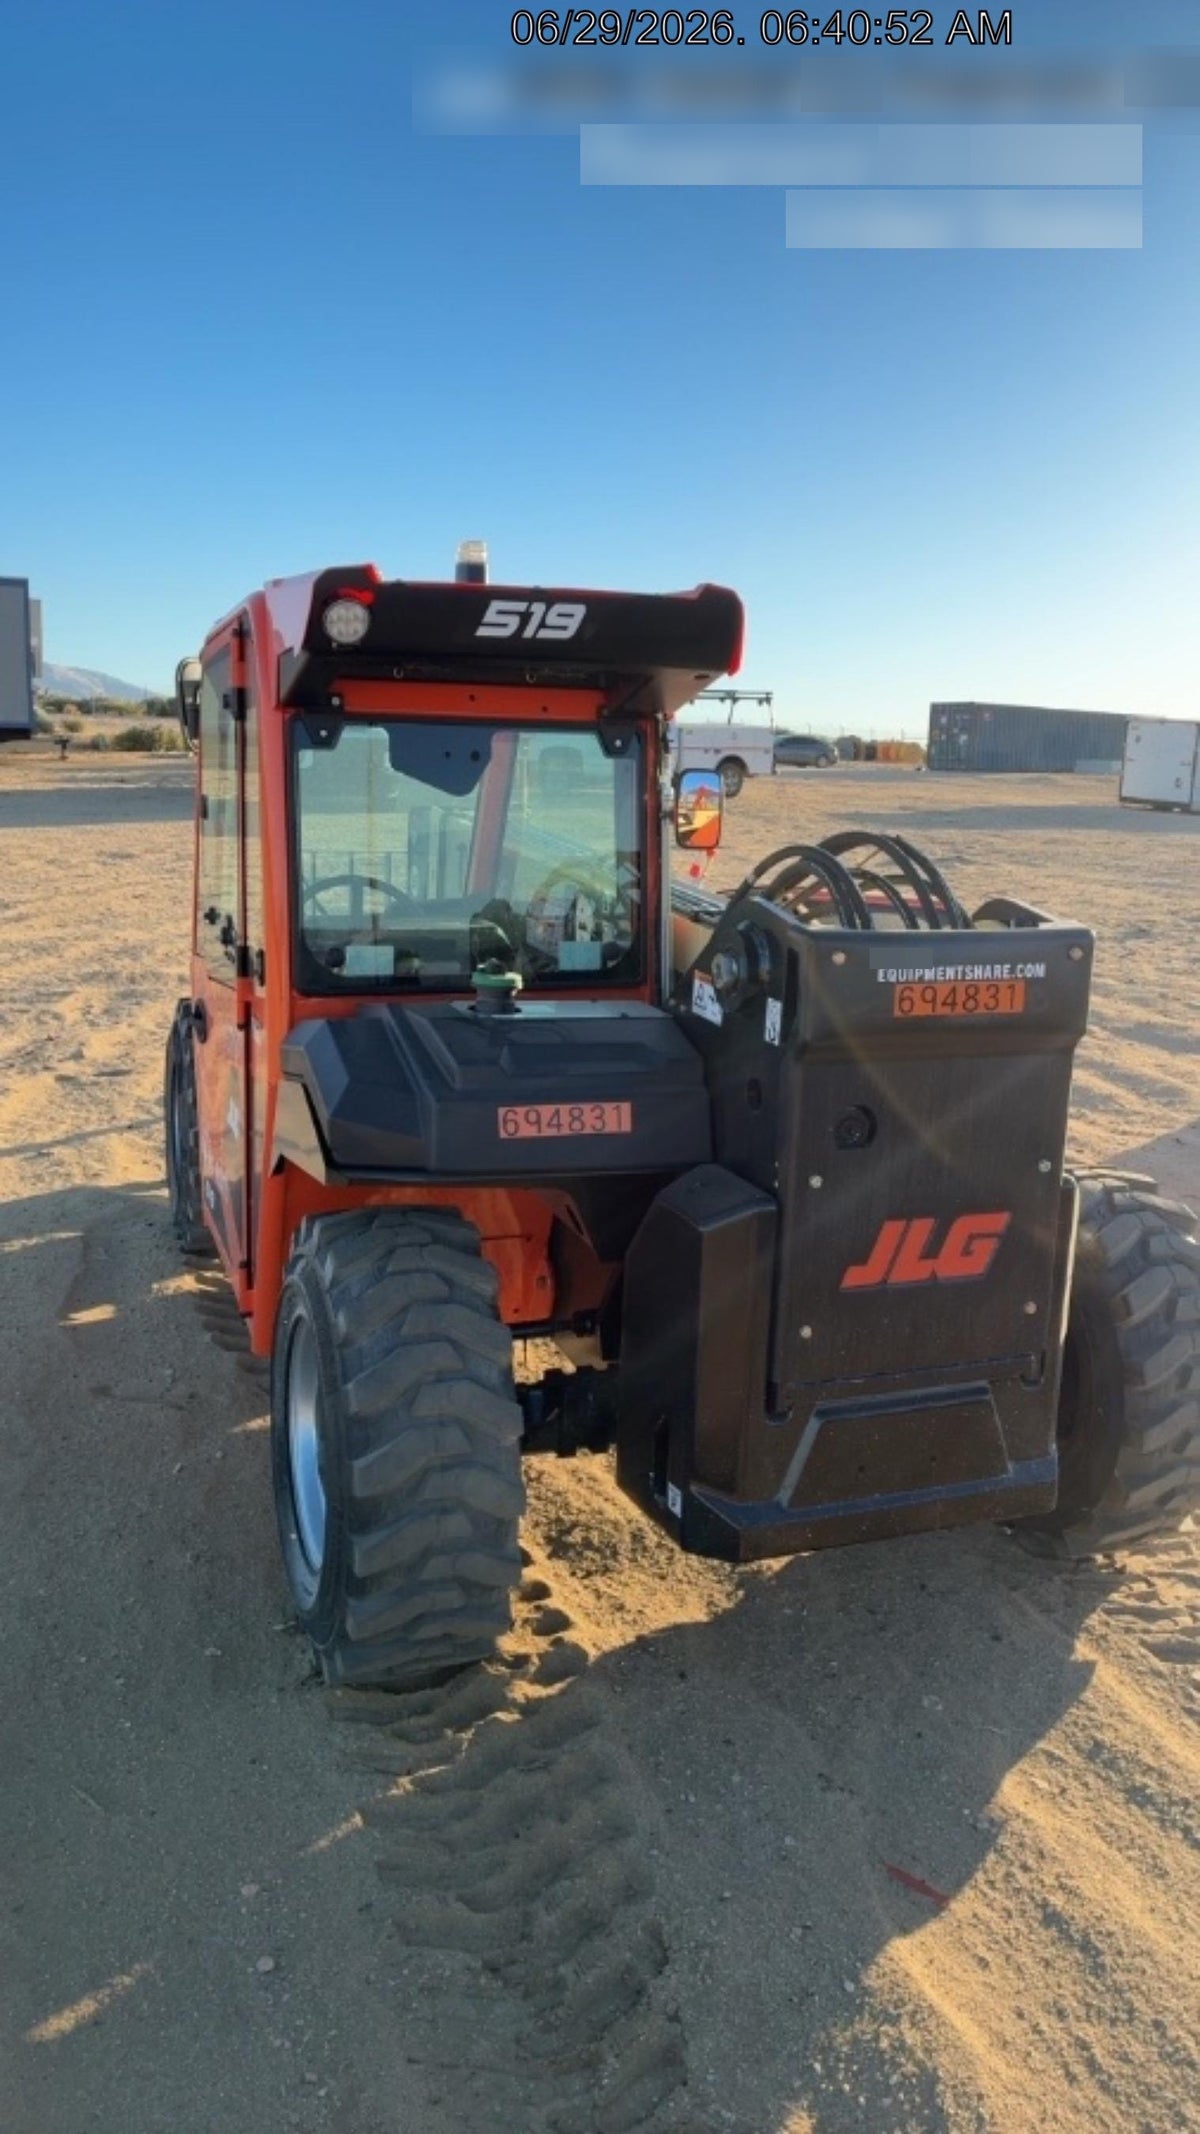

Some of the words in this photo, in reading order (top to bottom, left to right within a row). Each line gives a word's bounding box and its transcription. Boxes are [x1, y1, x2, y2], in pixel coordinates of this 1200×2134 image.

[474, 599, 587, 639] 519
[876, 962, 1047, 983] EQUIPMENTSHARE.COM
[898, 983, 1017, 1014] 694831
[502, 1103, 623, 1137] 694831
[839, 1211, 1012, 1290] JLG
